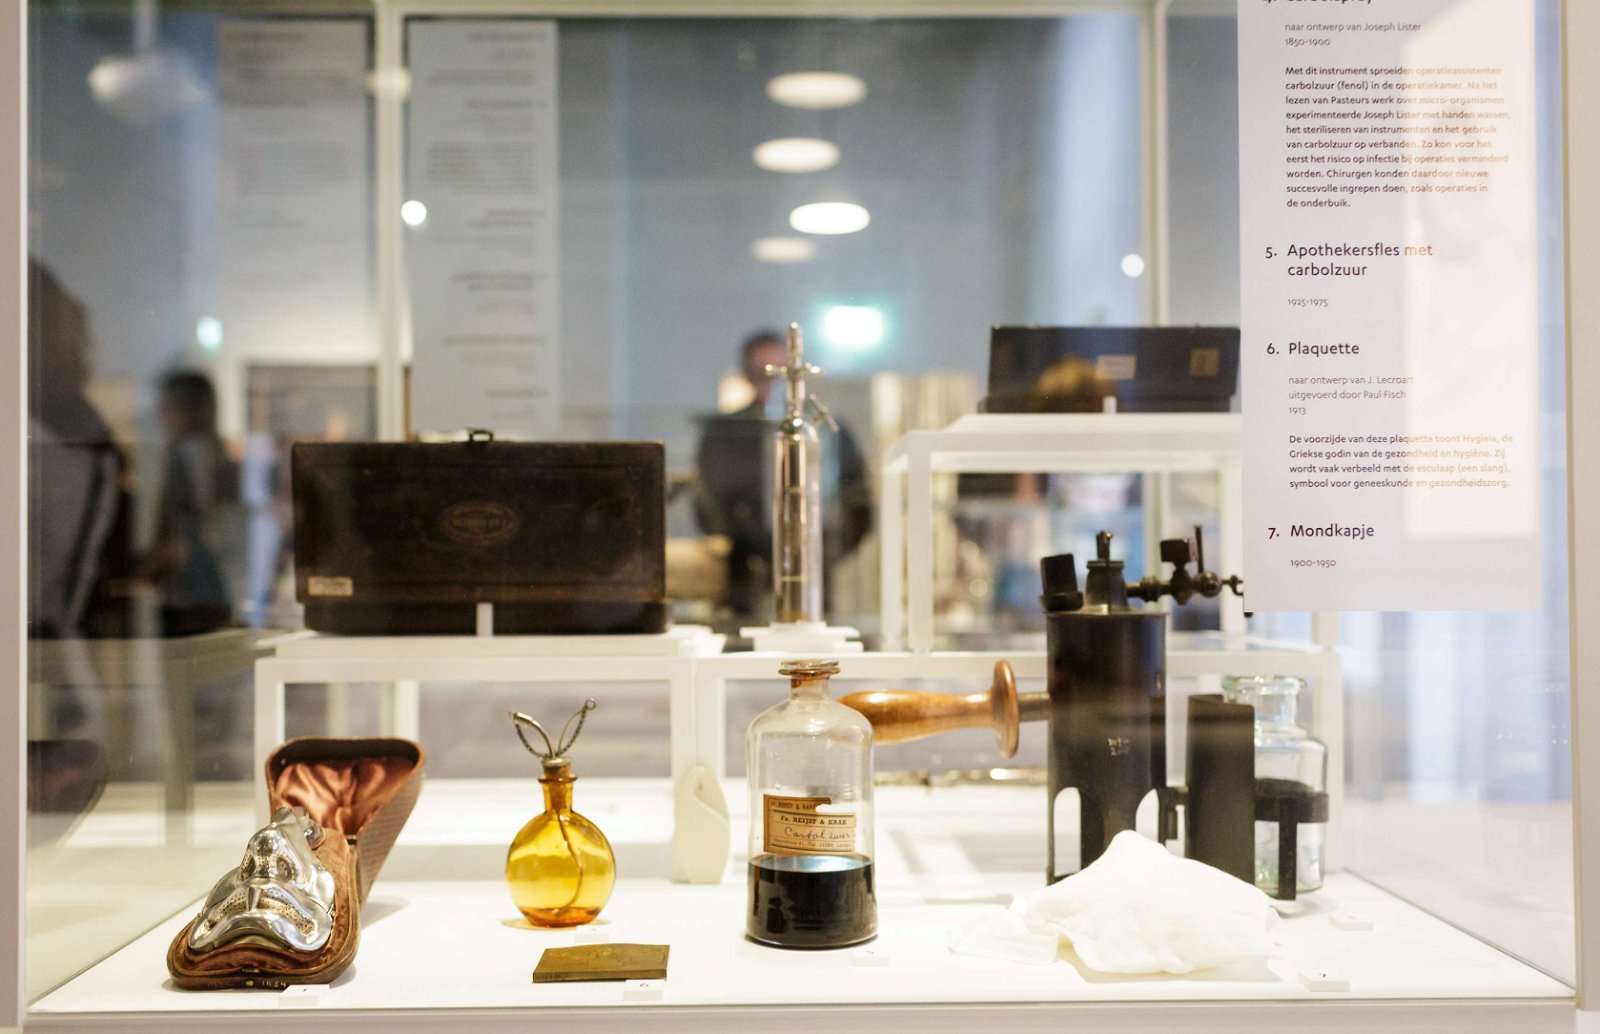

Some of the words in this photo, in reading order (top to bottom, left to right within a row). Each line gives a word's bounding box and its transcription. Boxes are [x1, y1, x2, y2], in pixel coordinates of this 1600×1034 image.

[1307, 22, 1344, 33] ontwerp
[1364, 22, 1395, 33] Joseph
[1398, 22, 1421, 31] Lister
[1286, 37, 1330, 47] 1850-1900
[1286, 66, 1303, 75] Met
[1305, 66, 1317, 75] dit
[1319, 66, 1367, 75] instrument
[1370, 66, 1414, 78] sproeiden
[1286, 80, 1334, 90] carbolzuur
[1338, 80, 1368, 91] (fenol)
[1371, 81, 1379, 90] in
[1382, 80, 1393, 90] de
[1286, 95, 1310, 104] lezen
[1331, 95, 1369, 104] Pasteurs
[1372, 95, 1394, 104] werk
[1286, 110, 1361, 122] experimenteerde
[1364, 110, 1394, 122] Joseph
[1396, 110, 1420, 119] Lister
[1423, 110, 1440, 119] met
[1442, 110, 1475, 119] handen
[1286, 124, 1300, 134] het
[1303, 124, 1351, 134] steriliseren
[1353, 126, 1369, 134] van
[1371, 125, 1430, 134] instrumenten
[1432, 126, 1443, 134] en
[1445, 124, 1460, 134] het
[1462, 124, 1497, 136] gebruik
[1304, 139, 1352, 148] carbolzuur
[1355, 141, 1366, 151] op
[1368, 139, 1419, 148] verbanden.
[1422, 139, 1433, 148] Zo
[1435, 139, 1452, 148] kon
[1477, 139, 1492, 148] het
[1286, 154, 1308, 163] eerst
[1311, 154, 1325, 163] het
[1327, 154, 1351, 163] risico
[1353, 156, 1364, 166] op
[1366, 154, 1400, 163] infectie
[1401, 154, 1412, 166] bij
[1415, 154, 1455, 166] operaties
[1457, 154, 1509, 163] verminderd
[1287, 168, 1323, 178] worden.
[1327, 168, 1372, 180] Chirurgen
[1375, 168, 1409, 178] konden
[1412, 168, 1453, 178] daardoor
[1456, 169, 1488, 178] nieuwe
[1287, 183, 1337, 192] succesvolle
[1340, 184, 1380, 195] ingrepen
[1383, 183, 1408, 194] doen,
[1411, 183, 1433, 192] zoals
[1435, 184, 1477, 195] operaties
[1479, 184, 1488, 192] in
[1287, 198, 1298, 207] de
[1301, 198, 1350, 207] onderbuik.
[1265, 246, 1277, 259] 5.
[1287, 243, 1400, 259] Apothekersfles
[1405, 245, 1432, 257] met
[1287, 262, 1367, 276] carbolzuur
[1288, 298, 1328, 308] 1925-1975
[1267, 342, 1279, 355] 6.
[1289, 341, 1359, 357] Plaquette
[1289, 377, 1307, 385] naar
[1310, 376, 1348, 387] ontwerp
[1350, 377, 1365, 385] van
[1367, 375, 1374, 386] J.
[1289, 390, 1337, 402] uitgevoerd
[1340, 390, 1360, 399] door
[1364, 390, 1381, 399] Paul
[1384, 390, 1406, 399] Fisch
[1289, 406, 1306, 416] 1913
[1290, 434, 1301, 444] De
[1304, 434, 1346, 446] voorzijde
[1348, 436, 1364, 444] van
[1366, 434, 1387, 444] deze
[1390, 434, 1433, 446] plaquette
[1502, 434, 1513, 444] de
[1290, 449, 1323, 458] Griekse
[1325, 449, 1351, 461] godin
[1372, 449, 1383, 458] de
[1385, 449, 1438, 461] gezondheid
[1290, 463, 1316, 473] wordt
[1319, 463, 1339, 473] vaak
[1342, 463, 1381, 473] verbeeld
[1384, 464, 1401, 473] met
[1403, 463, 1414, 473] de
[1290, 478, 1328, 490] symbool
[1354, 478, 1413, 490] geneeskunde
[1429, 478, 1509, 490] gezondheidszorg.
[1269, 527, 1279, 540] 7.
[1291, 523, 1374, 540] Mondkapje
[1291, 559, 1336, 569] 1900-1950
